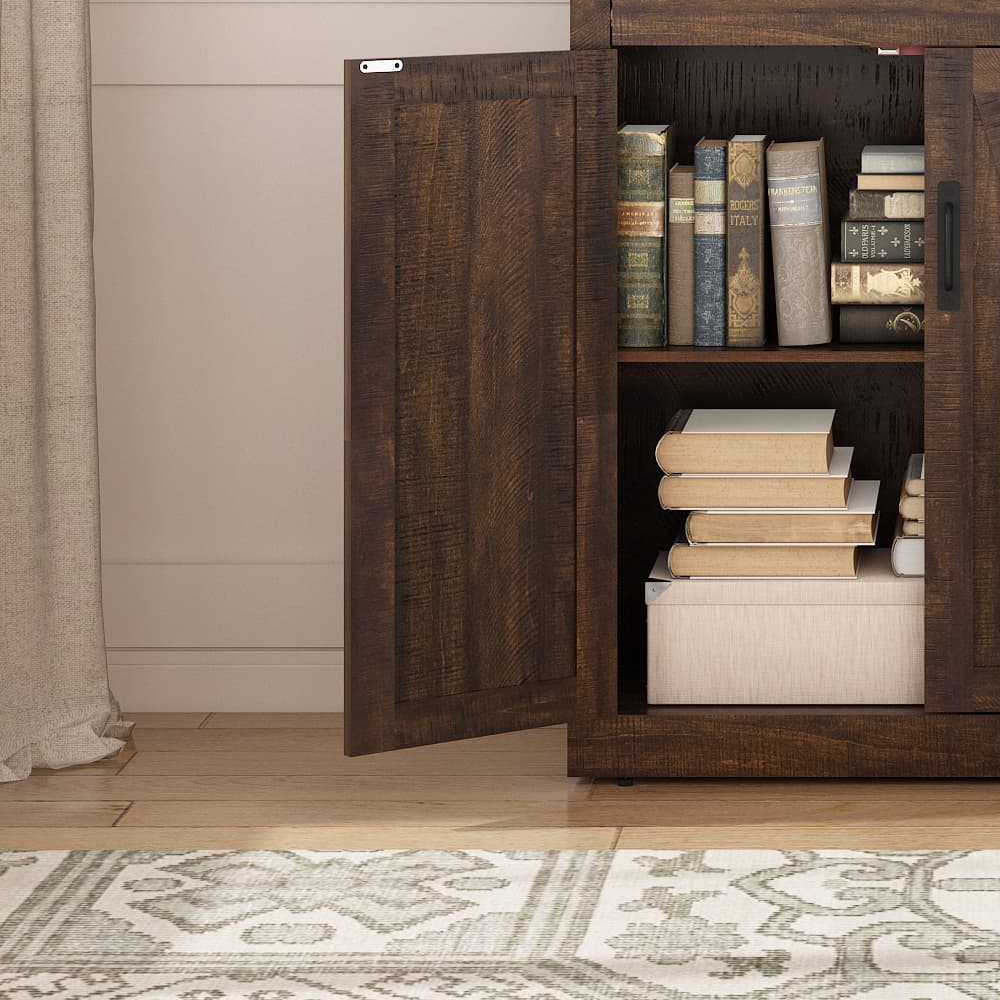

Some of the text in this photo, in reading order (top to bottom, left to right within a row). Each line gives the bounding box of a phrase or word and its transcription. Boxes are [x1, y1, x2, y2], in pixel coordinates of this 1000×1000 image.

[729, 215, 759, 226] ITALY
[861, 224, 869, 259] OLD PARIS
